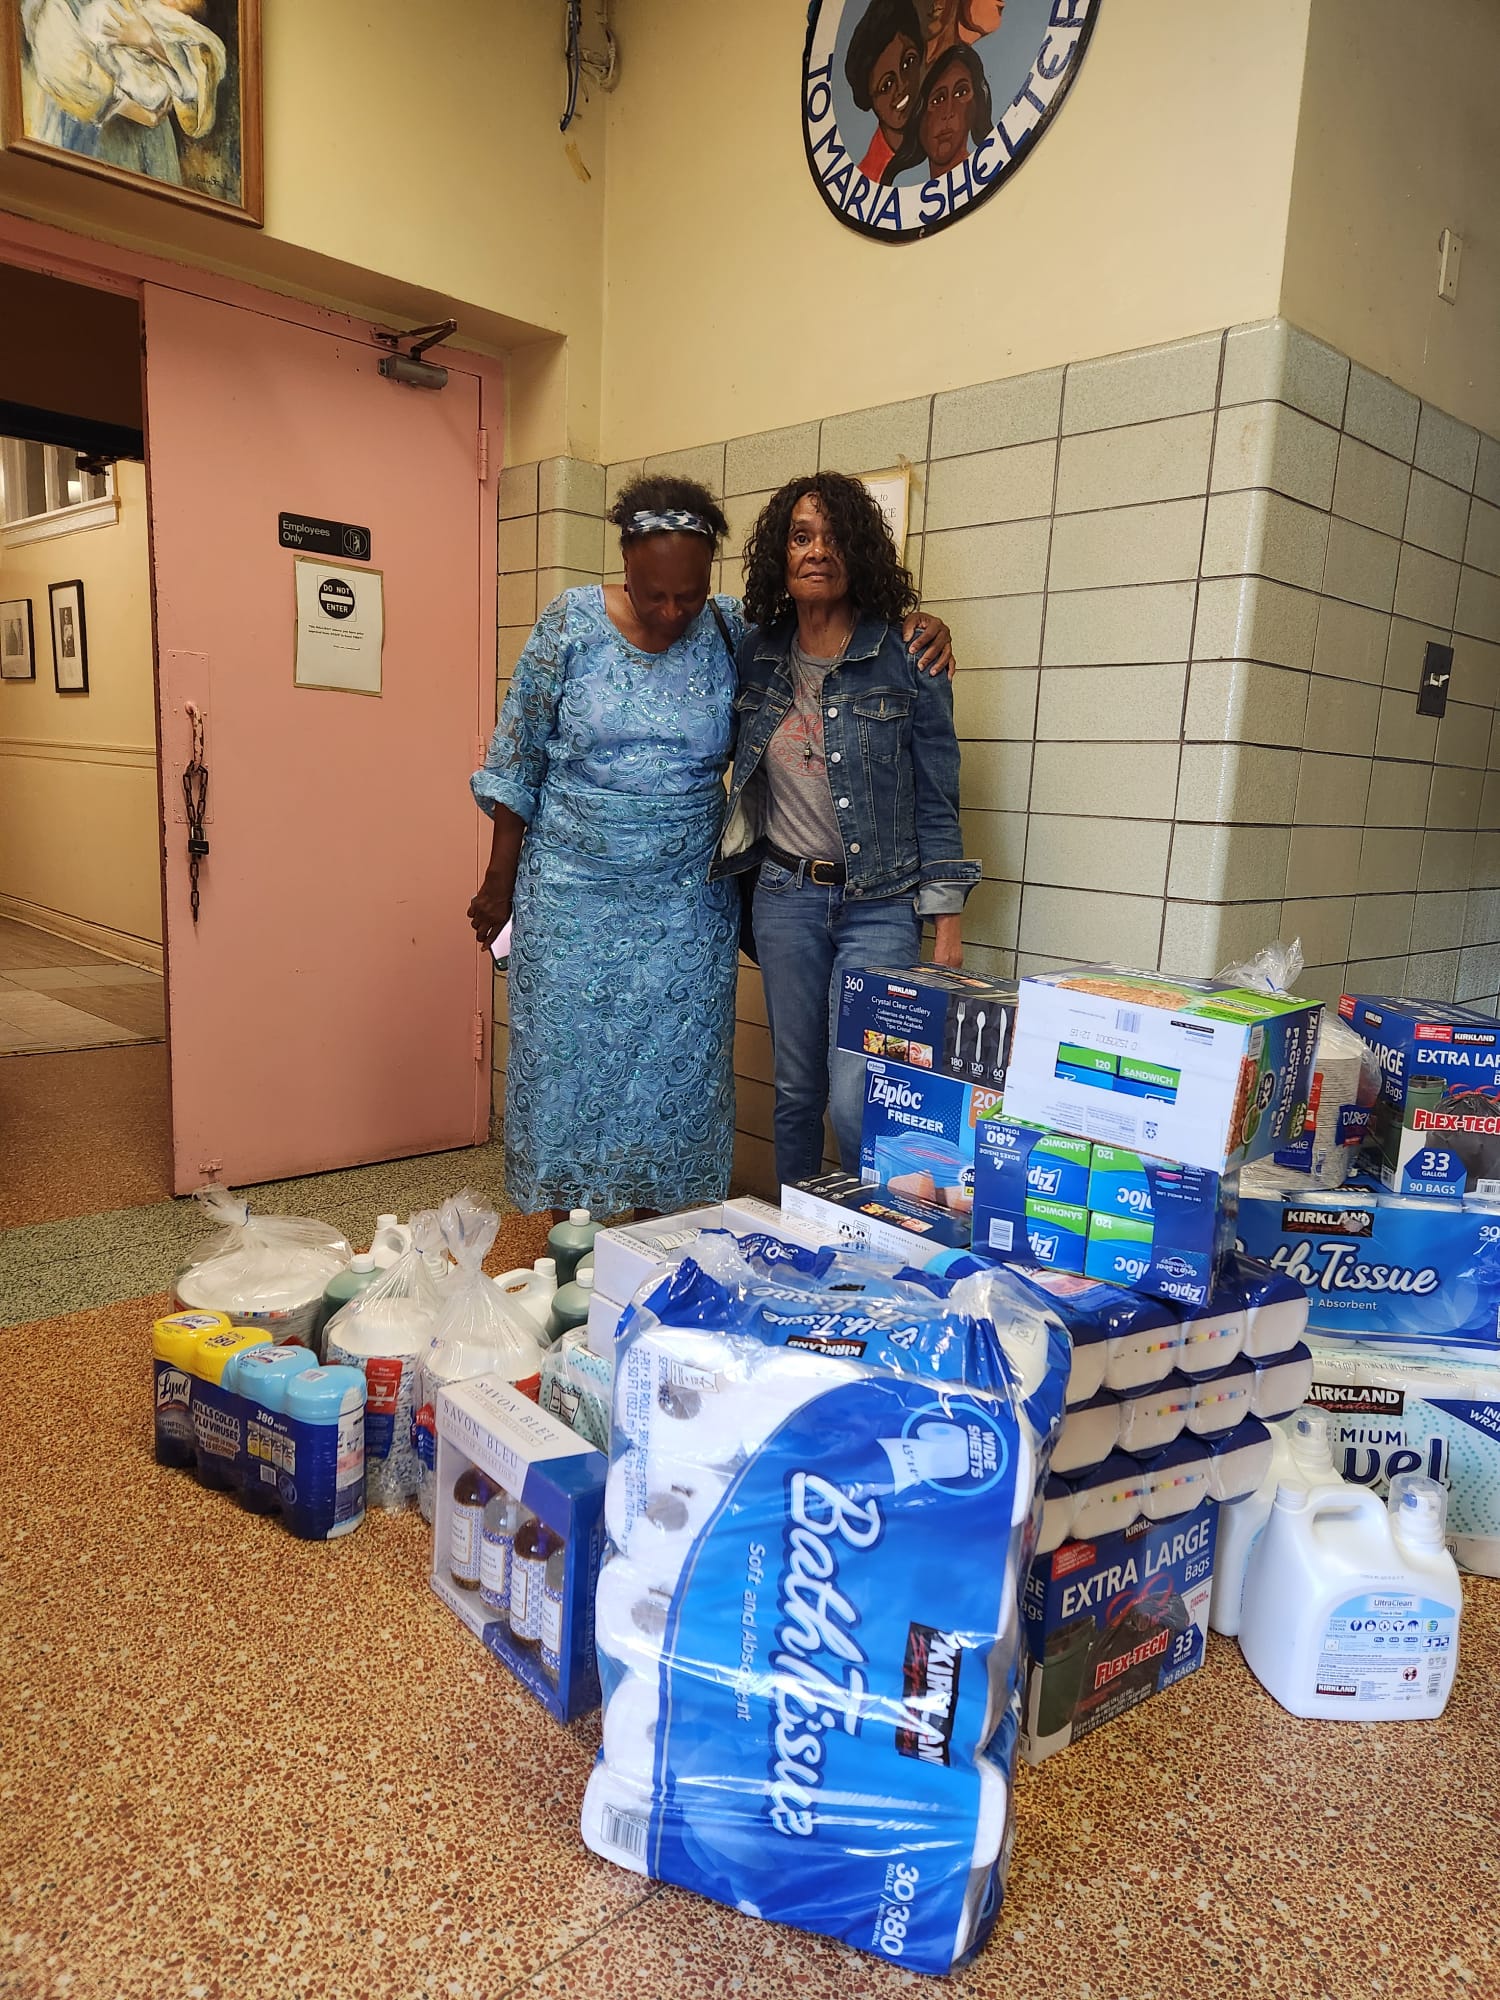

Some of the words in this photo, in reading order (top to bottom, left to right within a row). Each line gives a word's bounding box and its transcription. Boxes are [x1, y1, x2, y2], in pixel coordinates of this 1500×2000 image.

[282, 520, 331, 537] Employees
[282, 531, 303, 545] Only
[323, 584, 333, 592] DO
[336, 586, 351, 595] NOT
[326, 603, 349, 613] ENTER
[844, 975, 864, 992] 360
[887, 984, 918, 996] KIRKLAND
[871, 995, 892, 1008] Crystal
[891, 1000, 909, 1010] Clear
[908, 1004, 931, 1016] Cutlery
[877, 1008, 898, 1019] Cubiertos
[886, 1022, 896, 1030] Tipo
[897, 1025, 912, 1033] Cristal
[1454, 1033, 1495, 1042] KIRKLAND
[1304, 1015, 1318, 1065] Ziploc
[950, 1057, 963, 1067] 180
[971, 1063, 984, 1073] 120
[993, 1069, 1004, 1078] 60
[1369, 1041, 1405, 1076] LARGE
[1417, 1049, 1470, 1066] EXTRA
[1094, 1058, 1111, 1070] 120
[1123, 1067, 1174, 1086] SANDWICH
[1272, 1027, 1300, 1138] PROTECTION
[873, 1077, 922, 1110] Ziploc
[1260, 1077, 1273, 1106] 3X
[1385, 1081, 1403, 1101] Bags
[887, 1109, 944, 1133] FREEZER
[984, 1123, 1000, 1131] BAGS
[1000, 1125, 1020, 1136] TOTAL
[986, 1130, 1016, 1147] 480
[979, 1148, 999, 1159] INSIDE
[993, 1157, 1004, 1170] 4
[999, 1152, 1020, 1162] BOXES
[1097, 1150, 1114, 1161] 120
[1421, 1151, 1449, 1171] 33
[1409, 1182, 1423, 1192] 90
[1425, 1183, 1456, 1195] BAGS
[1033, 1204, 1083, 1220] SANDWICH
[1288, 1210, 1371, 1226] KIRKLAND
[1095, 1217, 1112, 1229] 120
[1320, 1244, 1438, 1293] Tissue
[1160, 1281, 1202, 1302] Ziploc
[1318, 1299, 1377, 1310] Absorbent
[787, 1340, 861, 1356] KIRKLAND
[159, 1372, 188, 1402] Lysol
[627, 1379, 638, 1389] FT
[193, 1399, 213, 1419] KILLS
[214, 1411, 234, 1427] COLD
[234, 1420, 240, 1430] &
[638, 1392, 650, 1420] ROLLS
[256, 1409, 274, 1425] 380
[194, 1414, 208, 1429] FLU
[209, 1421, 238, 1442] VIRUSES
[443, 1399, 481, 1440] SAVON
[486, 1434, 519, 1471] BLEU
[519, 1415, 560, 1443] BLEU
[967, 1424, 984, 1479] SHEETS
[982, 1431, 998, 1471] WIDE
[747, 1542, 766, 1586] Soft
[781, 1472, 881, 1664] Bath
[1061, 1558, 1139, 1618] EXTRA
[1144, 1518, 1210, 1576] LARGE
[1184, 1556, 1211, 1582] Bags
[740, 1589, 758, 1628] and
[1173, 1630, 1194, 1658] 33
[1094, 1629, 1169, 1690] FLEX-TECH
[1173, 1650, 1192, 1664] GALLON
[1163, 1673, 1175, 1687] 90
[1175, 1659, 1197, 1683] BAGS
[884, 1863, 896, 1892] ROLLS
[895, 1862, 919, 1902] 30
[880, 1905, 910, 1956] 380
